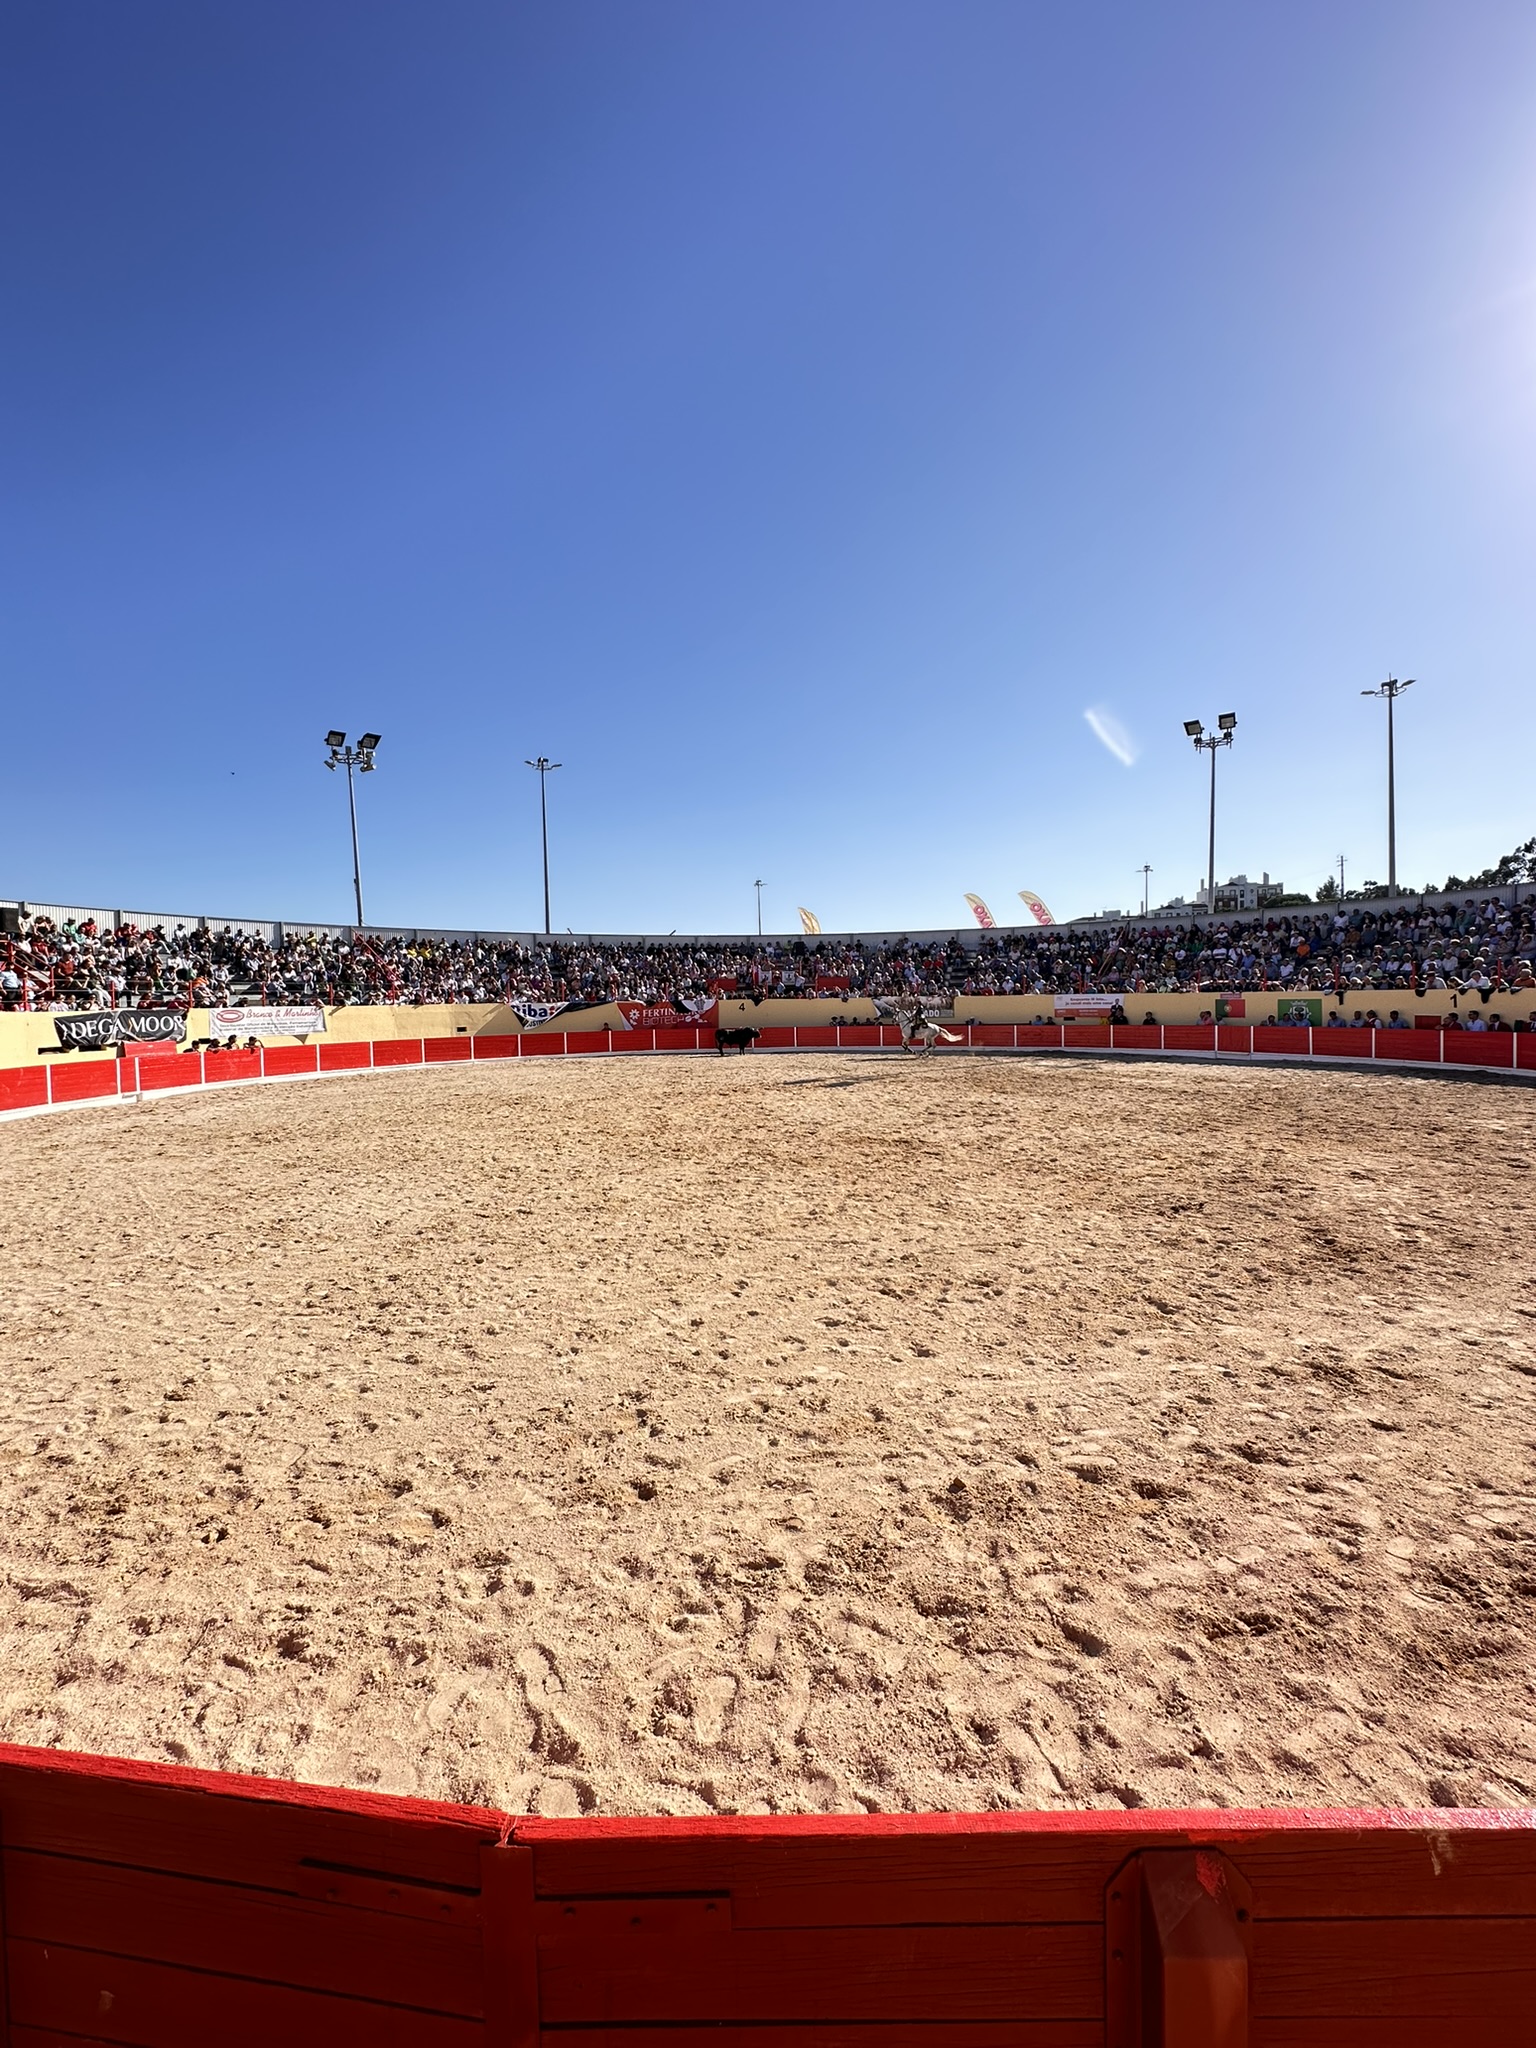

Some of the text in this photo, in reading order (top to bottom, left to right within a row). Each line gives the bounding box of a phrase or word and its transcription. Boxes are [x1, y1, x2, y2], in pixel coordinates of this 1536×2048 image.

[1449, 993, 1458, 1008] 1
[739, 1002, 746, 1012] 4
[246, 1009, 273, 1018] Branco
